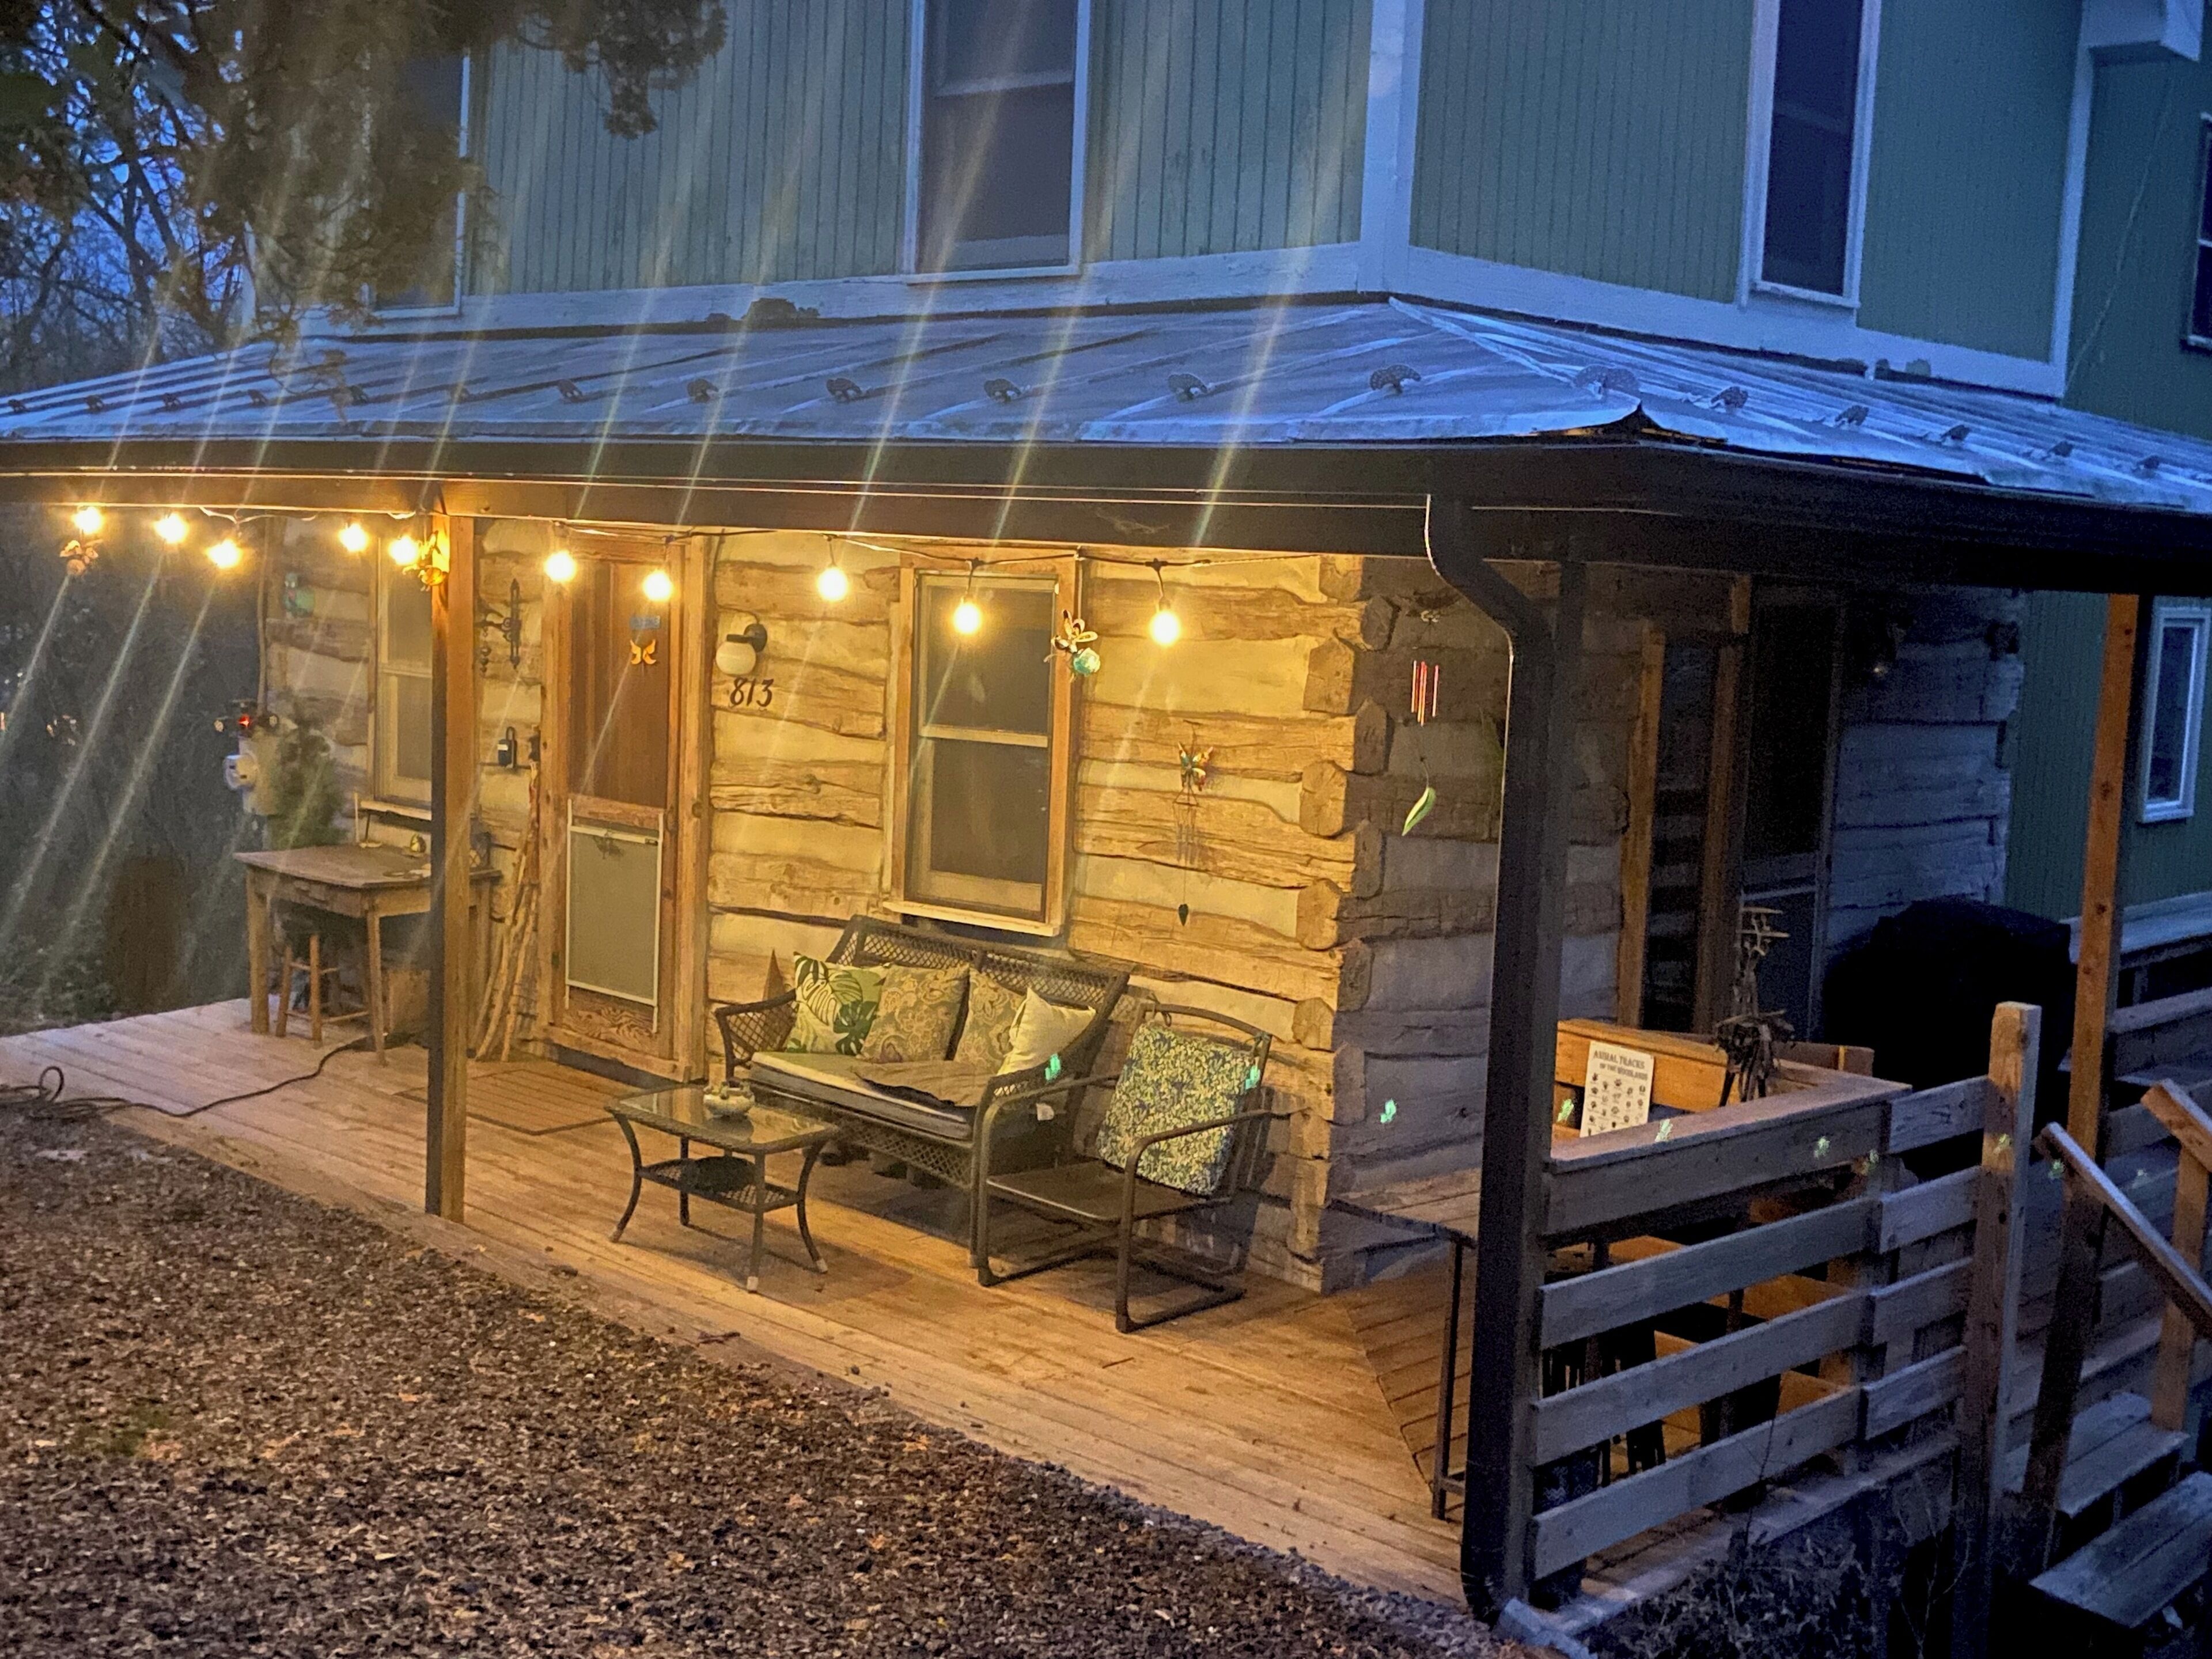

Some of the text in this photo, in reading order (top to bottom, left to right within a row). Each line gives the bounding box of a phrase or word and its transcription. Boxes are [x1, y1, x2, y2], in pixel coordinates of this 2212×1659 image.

[729, 676, 774, 707] 813
[1593, 1050, 1645, 1069] ANIMAL TRACKS
